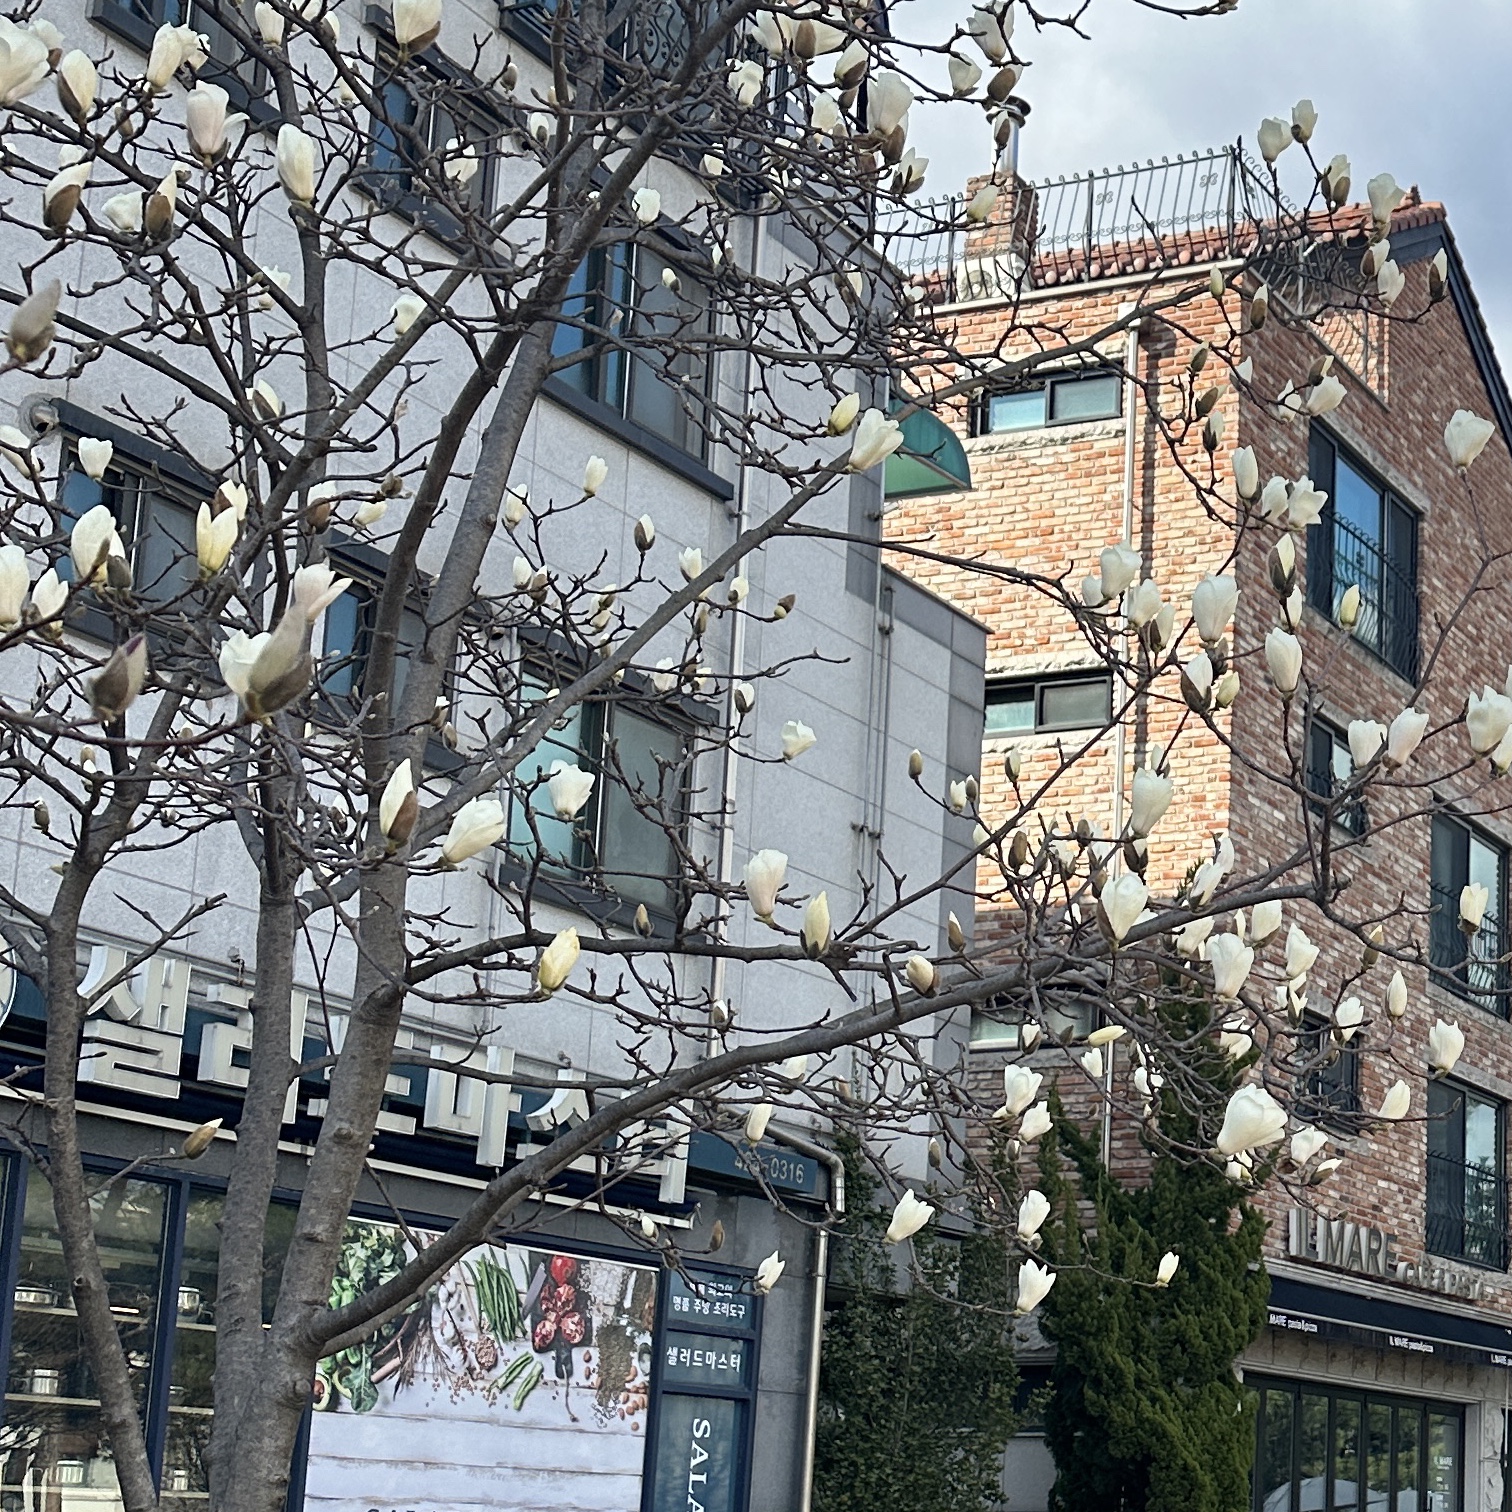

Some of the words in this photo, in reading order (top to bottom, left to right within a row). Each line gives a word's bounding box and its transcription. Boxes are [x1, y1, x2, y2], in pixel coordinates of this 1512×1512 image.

[1288, 1208, 1318, 1262] IL
[1315, 1214, 1399, 1278] MARE
[672, 1296, 690, 1312] 명품
[713, 1302, 746, 1319] 조리도구
